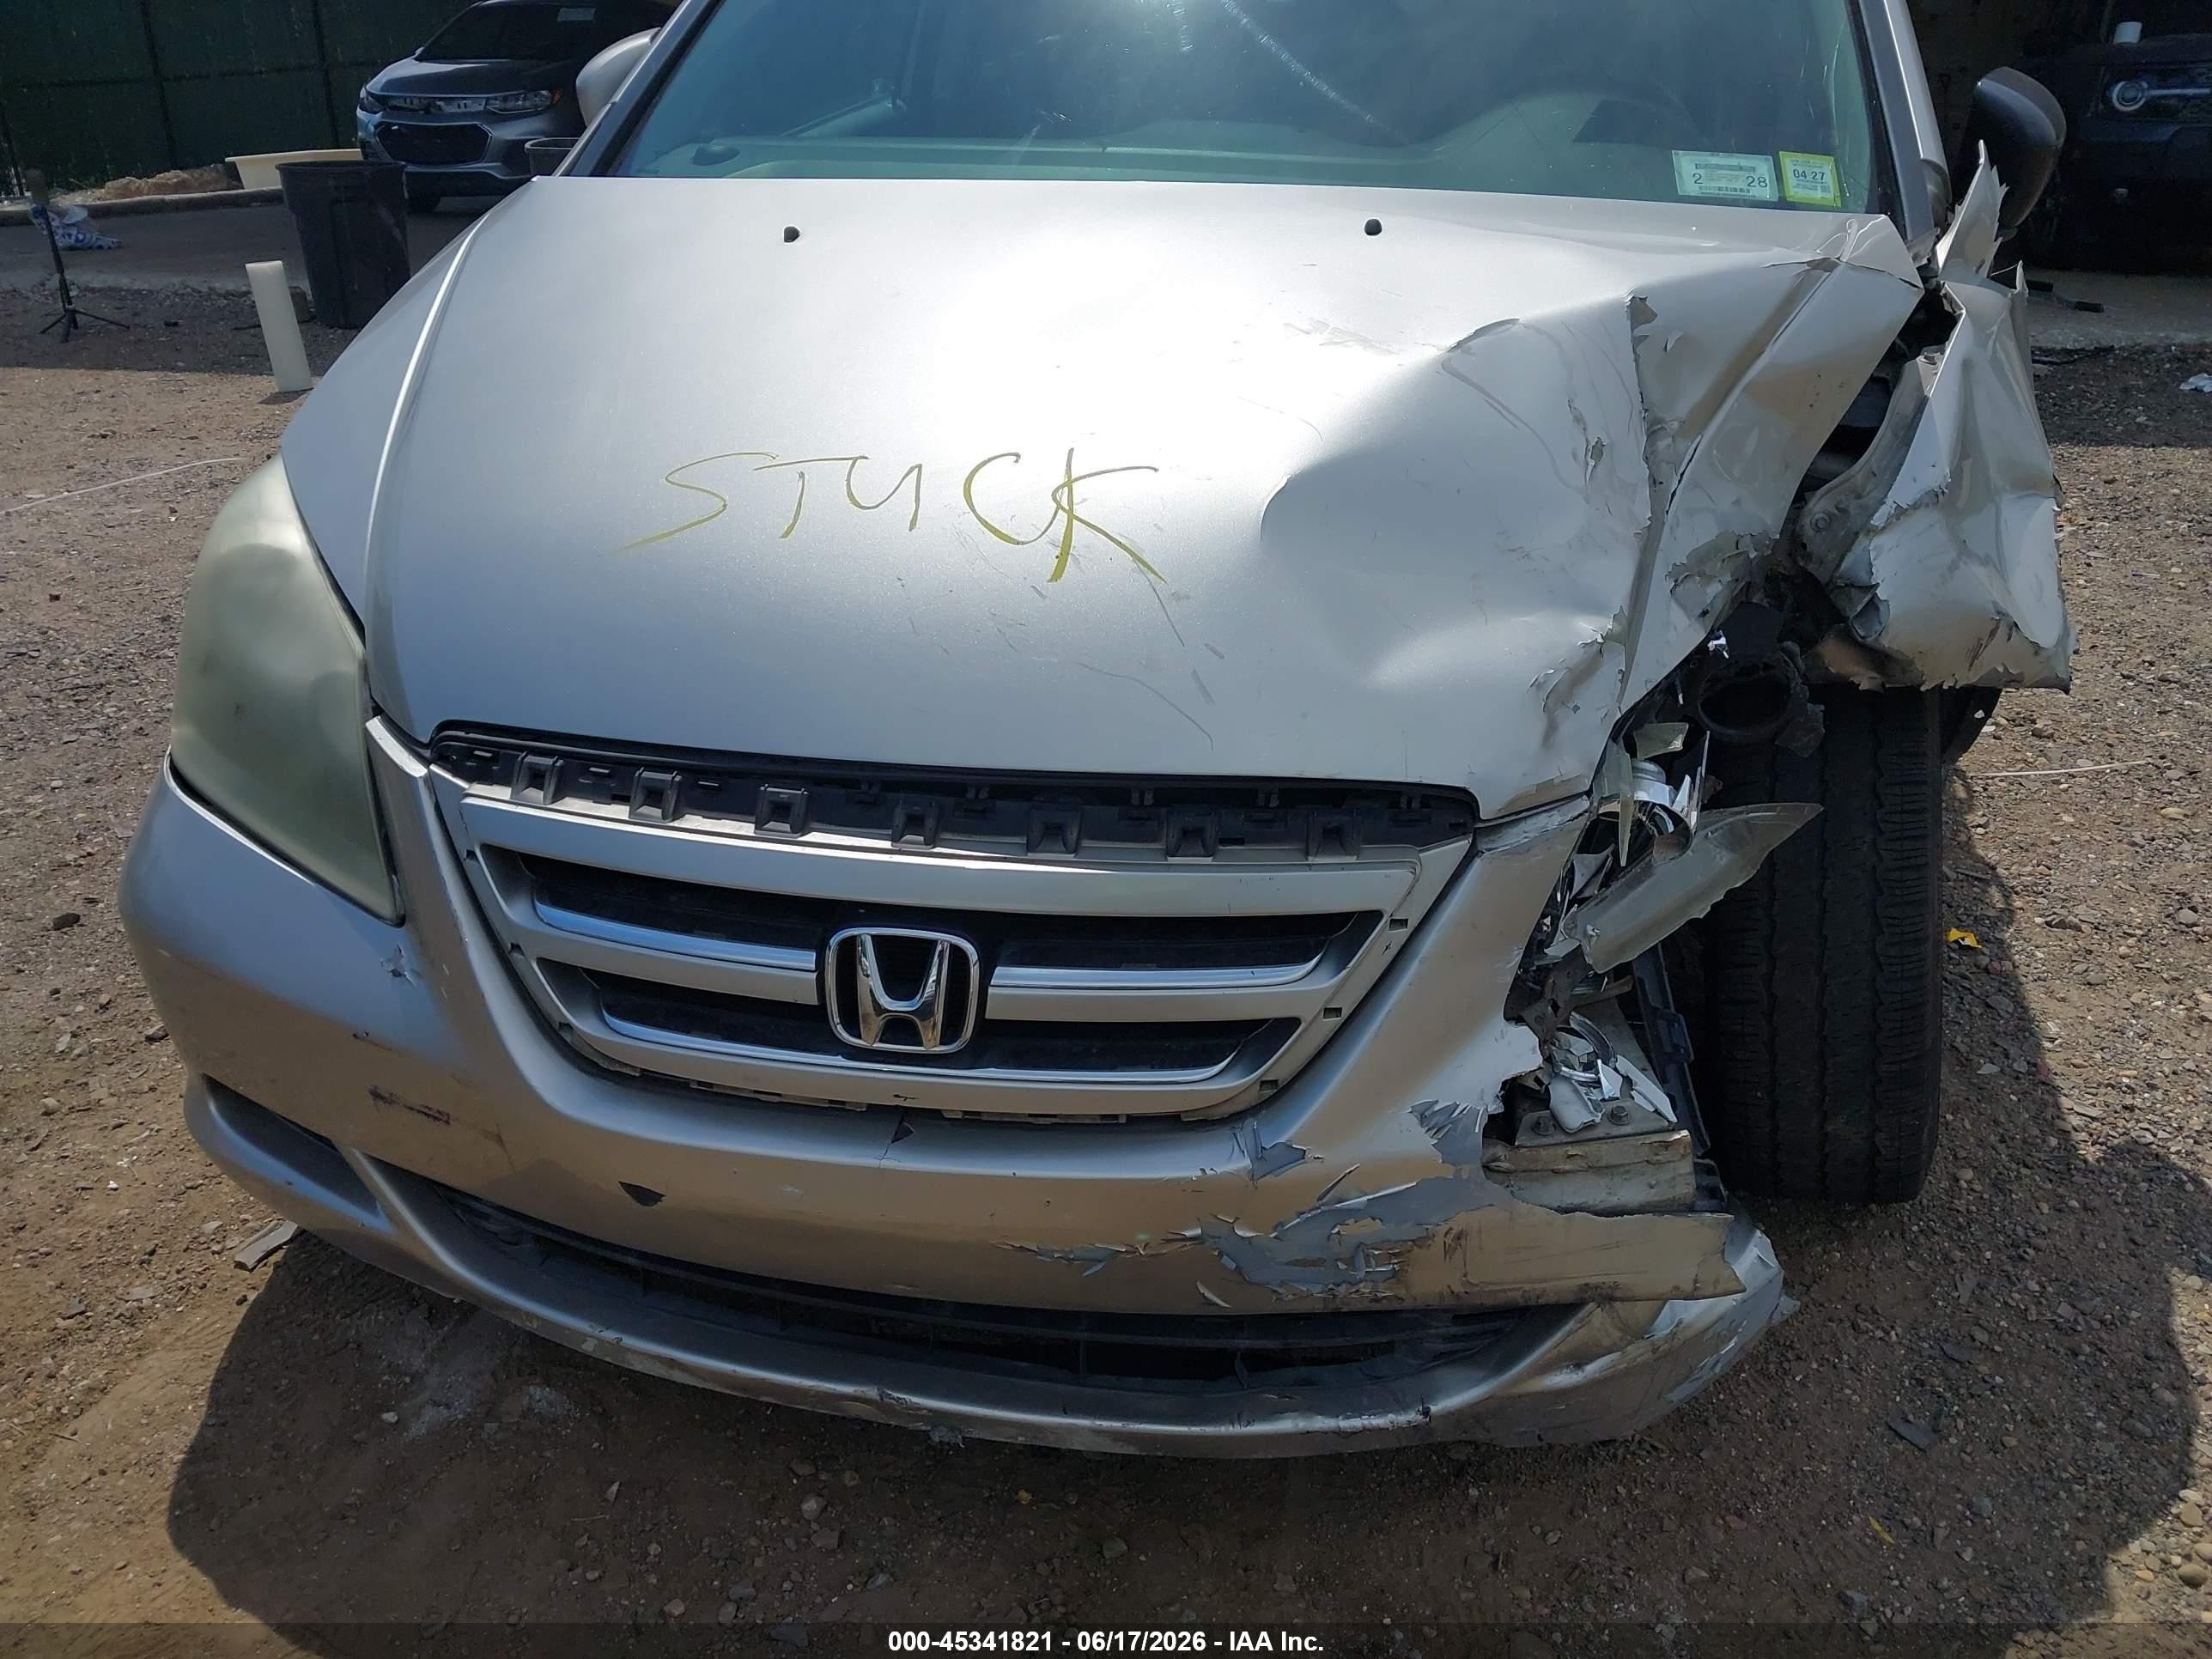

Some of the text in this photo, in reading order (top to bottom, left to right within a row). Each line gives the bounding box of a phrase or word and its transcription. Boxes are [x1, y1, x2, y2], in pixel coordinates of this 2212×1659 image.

[1692, 173, 1704, 185] 2
[1747, 175, 1768, 188] 28
[1793, 168, 1825, 180] 04 27
[613, 447, 1167, 584] STUCK
